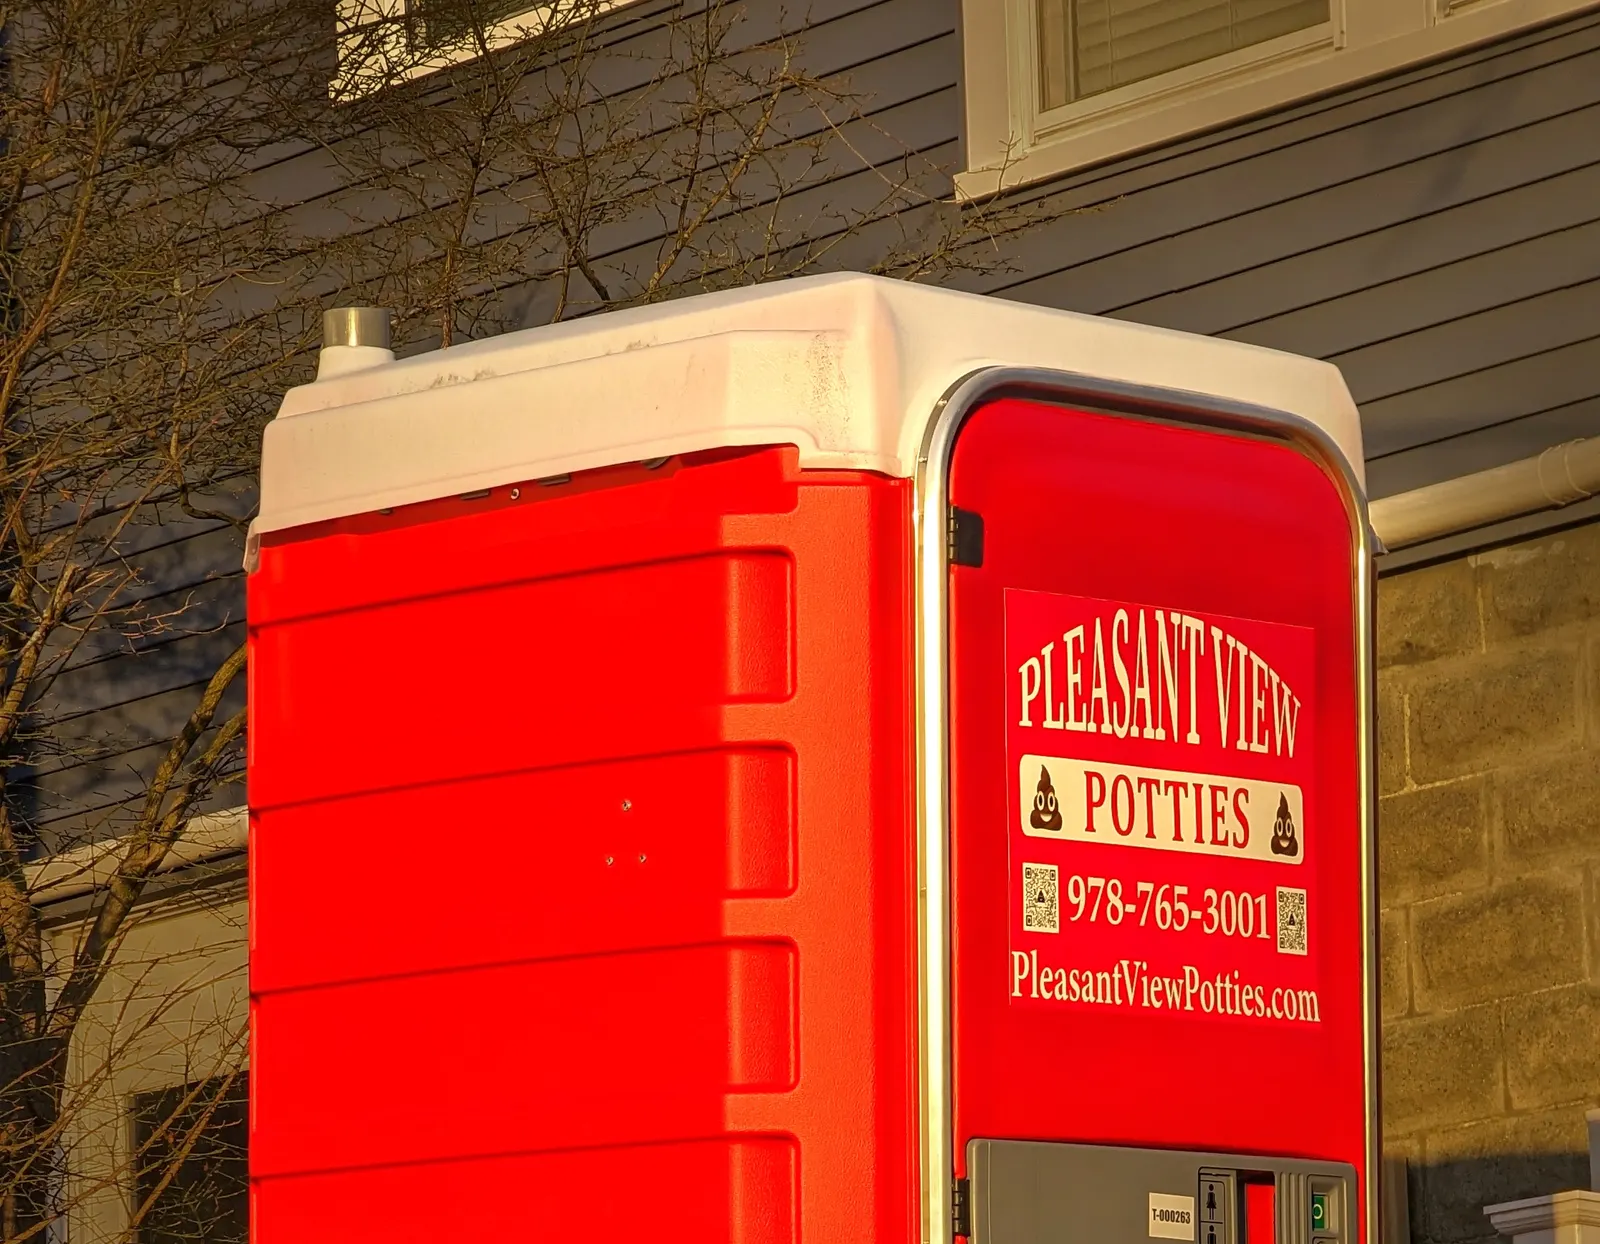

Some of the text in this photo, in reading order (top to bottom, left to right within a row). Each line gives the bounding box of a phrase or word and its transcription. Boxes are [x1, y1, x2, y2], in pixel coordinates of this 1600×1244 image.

[1019, 608, 1301, 758] PLEASANT VIEW
[1084, 770, 1250, 849] POTTIES
[1067, 875, 1271, 940] 978-765-3001
[1011, 950, 1321, 1023] PleasantViewPotties.com
[1152, 1208, 1191, 1225] T-000263
